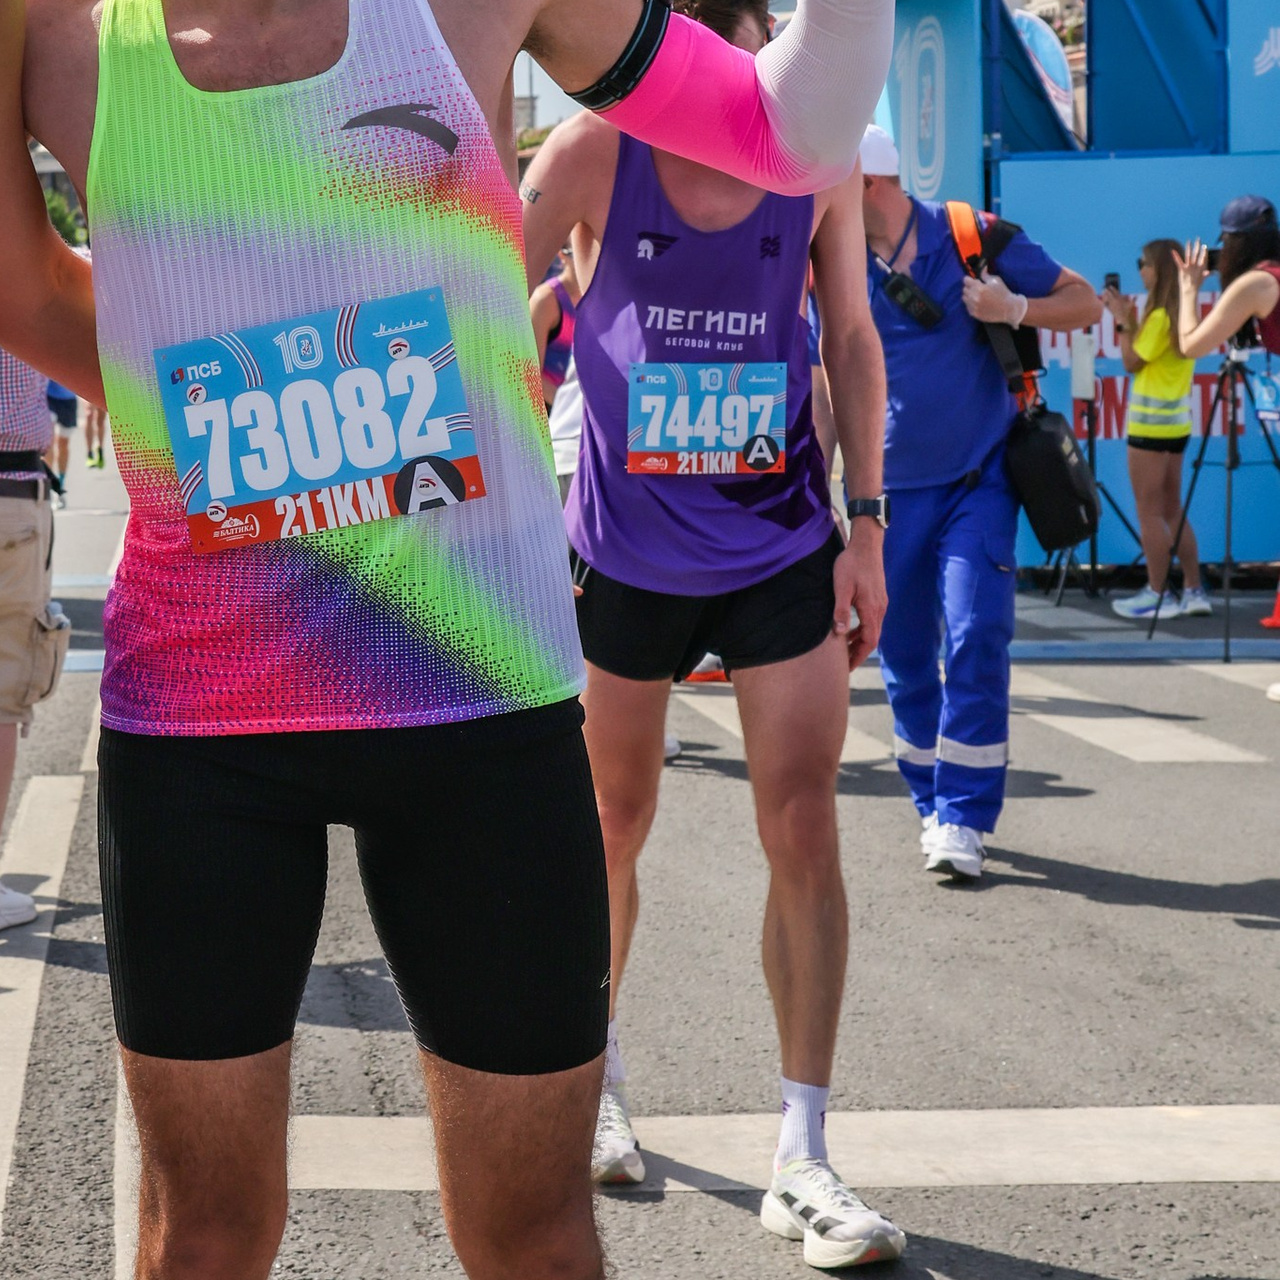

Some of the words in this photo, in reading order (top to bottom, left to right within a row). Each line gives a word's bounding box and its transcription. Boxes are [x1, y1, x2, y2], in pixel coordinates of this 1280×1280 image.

[645, 305, 767, 336] ЛЕГИОН
[273, 326, 324, 374] 10
[665, 337, 710, 349] БЕГОВОЙ
[717, 341, 744, 351] КЛУБ
[187, 360, 222, 381] ПСБ
[646, 375, 667, 384] ПСБ
[698, 368, 723, 391] 10
[183, 355, 452, 500] 73082
[641, 395, 774, 448] 74497
